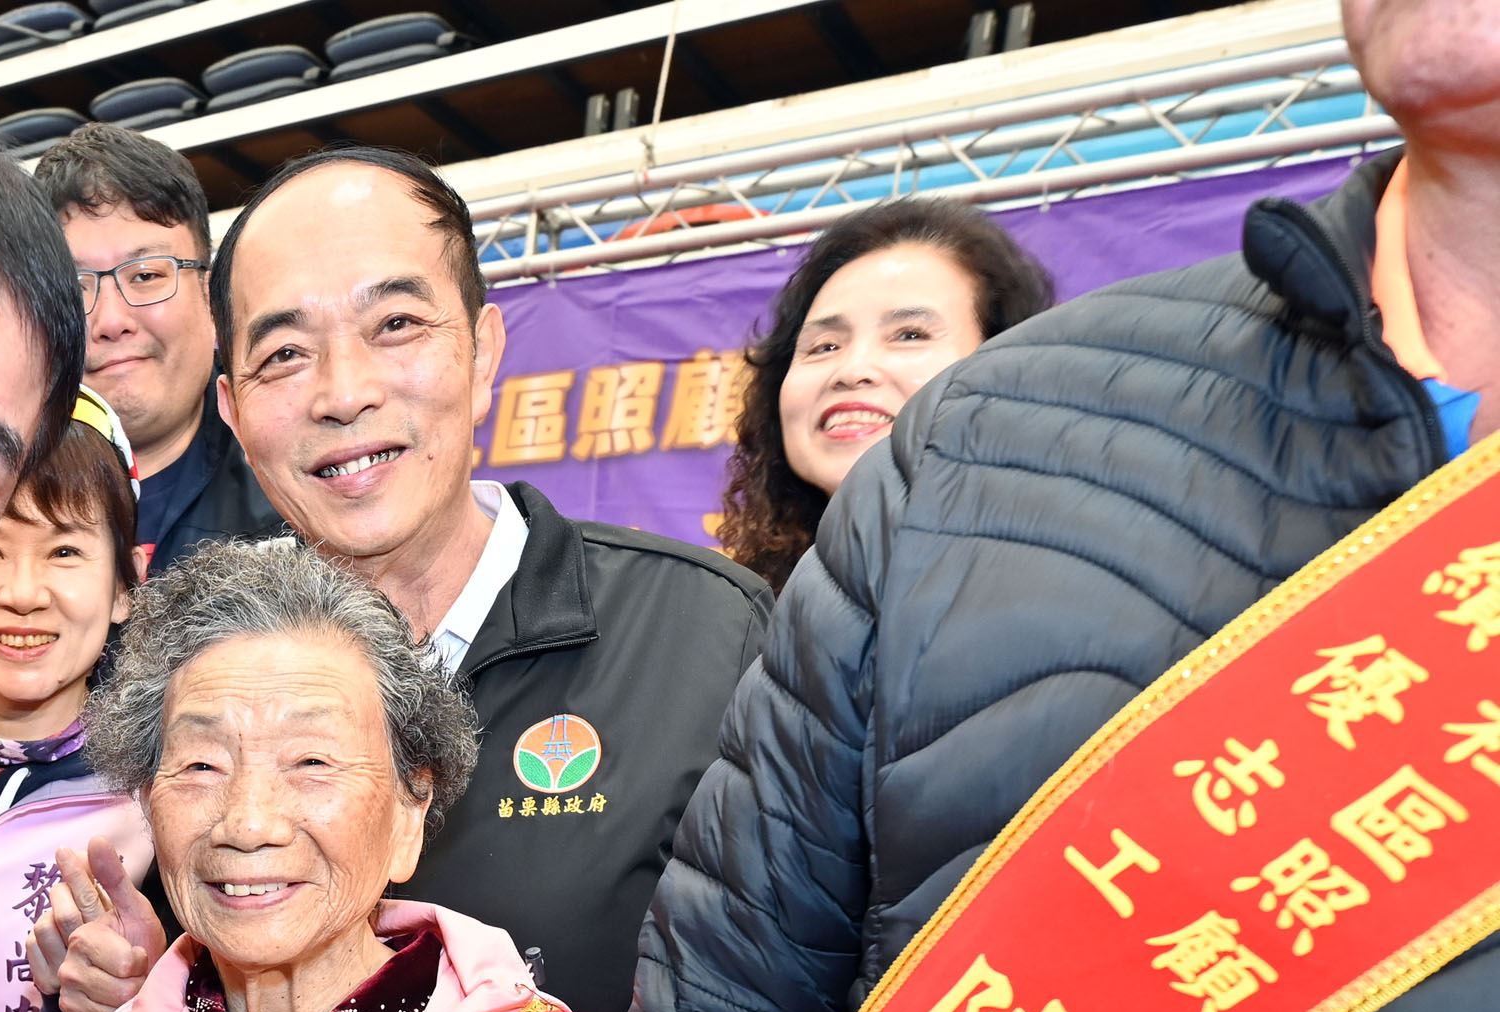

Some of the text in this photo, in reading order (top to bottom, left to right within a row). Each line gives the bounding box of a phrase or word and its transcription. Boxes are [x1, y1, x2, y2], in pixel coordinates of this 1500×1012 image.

[473, 348, 747, 469] 區照顧
[497, 792, 608, 818] 苗栗縣政府
